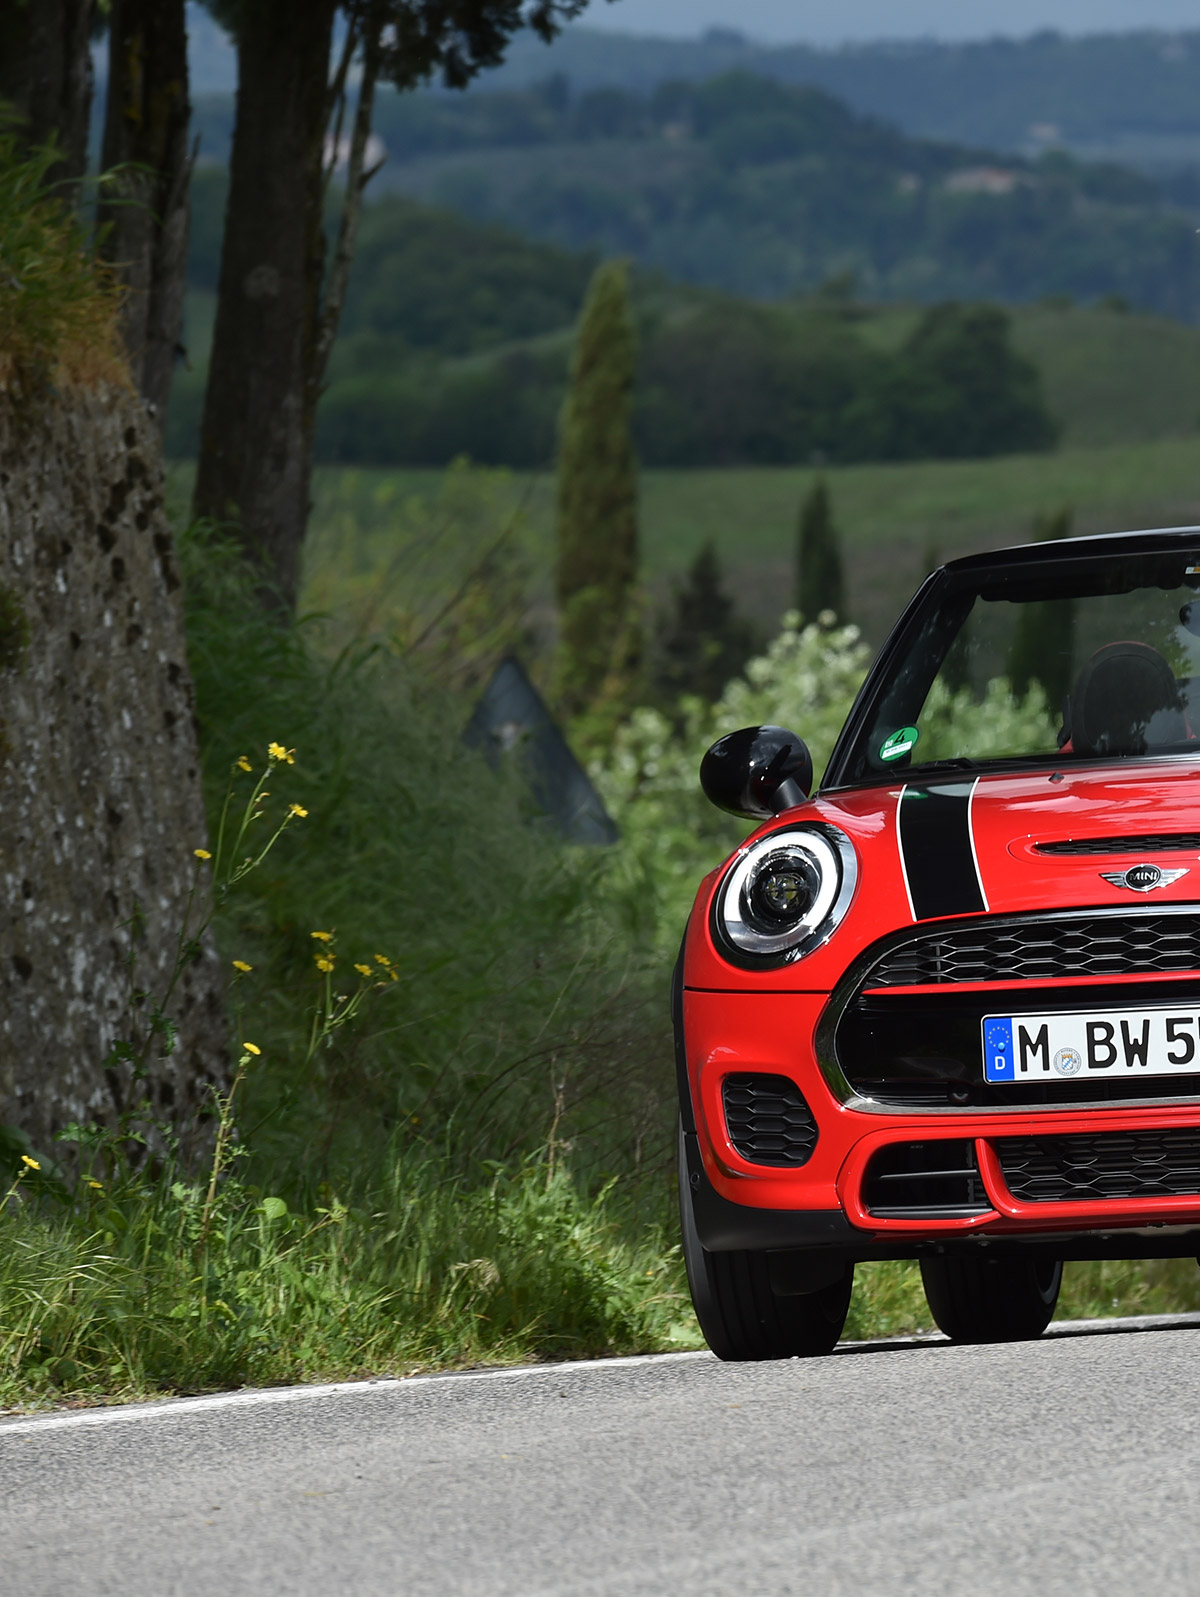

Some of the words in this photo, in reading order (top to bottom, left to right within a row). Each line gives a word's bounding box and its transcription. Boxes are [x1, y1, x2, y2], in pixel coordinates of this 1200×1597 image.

[894, 729, 905, 744] 4
[1129, 871, 1158, 881] MINI
[1018, 1023, 1049, 1072] M
[1086, 1019, 1150, 1069] BW
[994, 1056, 1006, 1070] D
